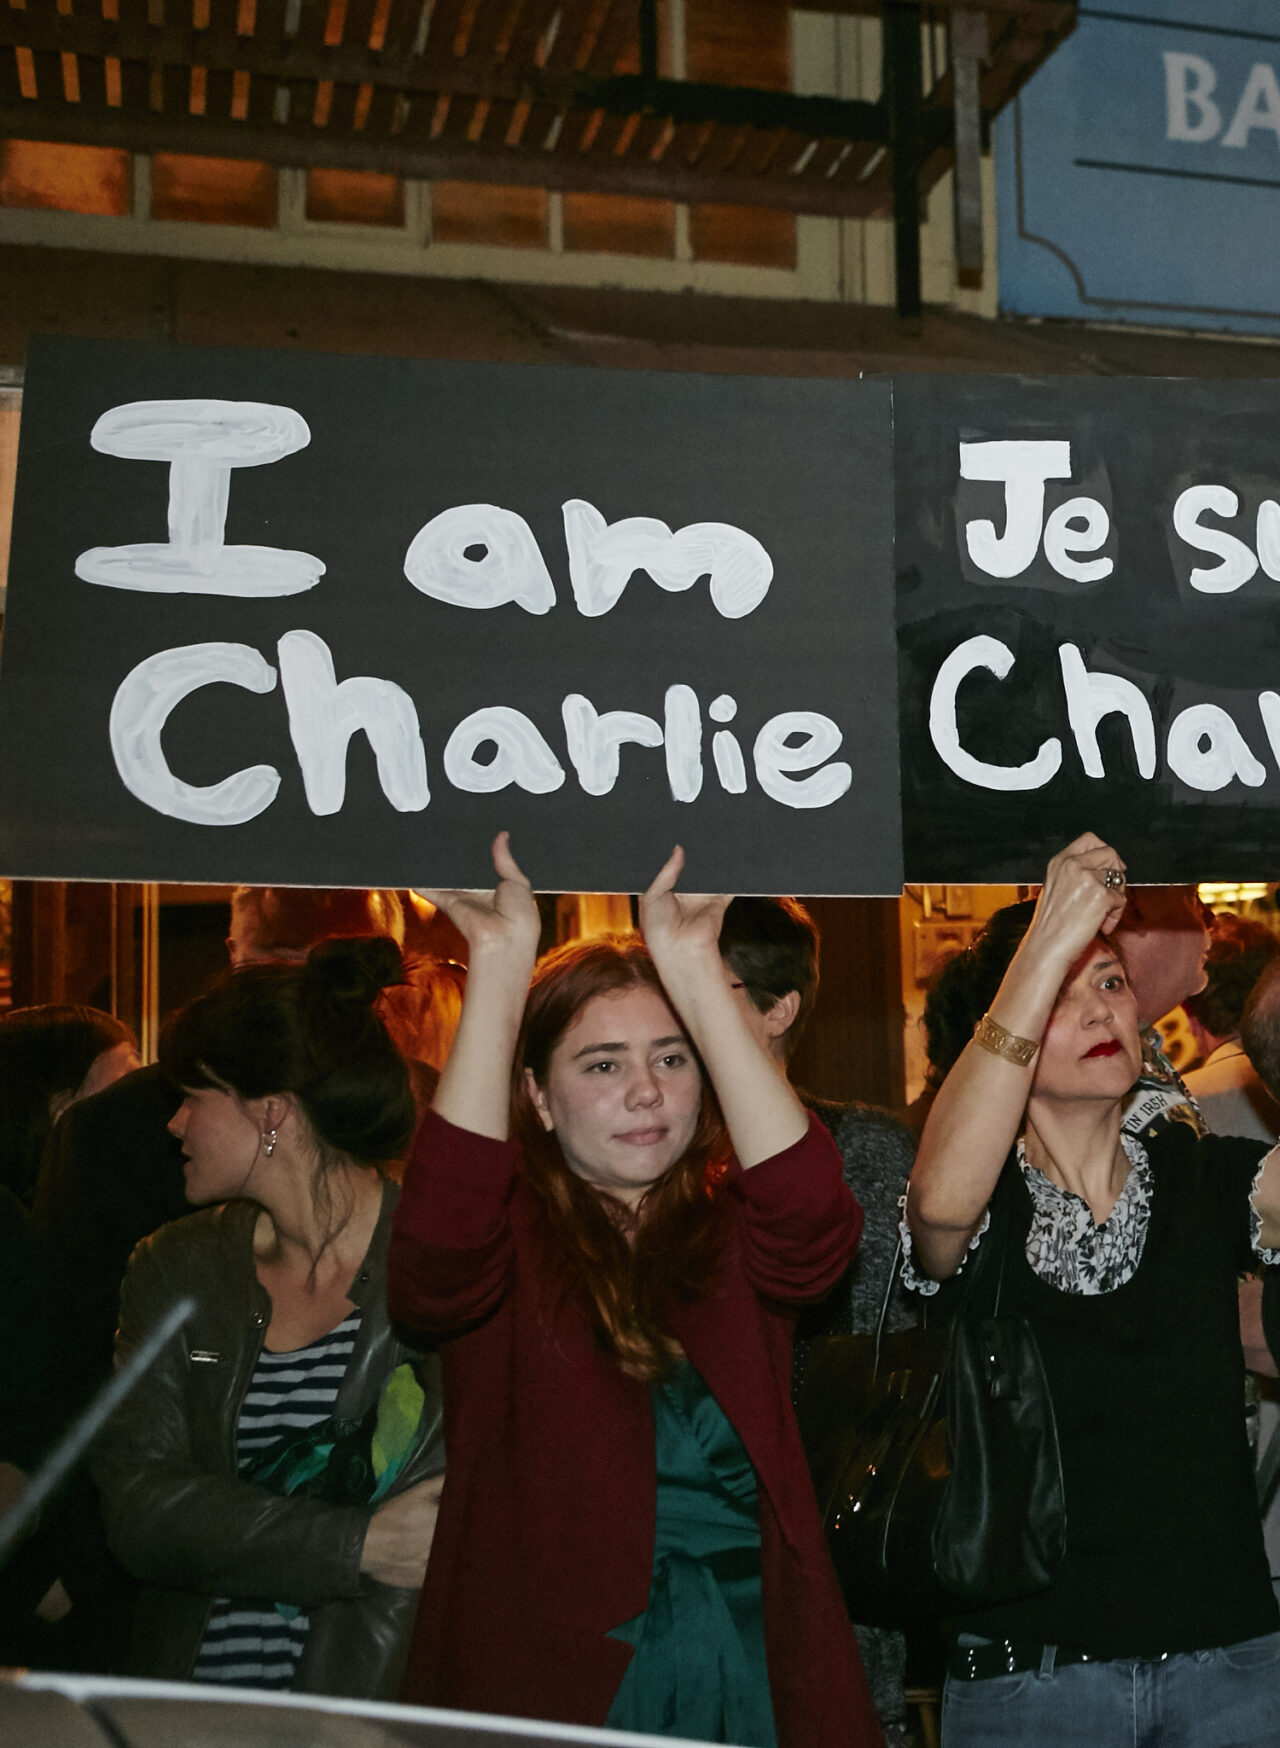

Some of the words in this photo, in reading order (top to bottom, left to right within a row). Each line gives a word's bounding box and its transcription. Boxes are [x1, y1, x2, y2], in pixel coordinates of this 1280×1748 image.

[74, 399, 327, 598] I
[403, 498, 775, 619] am
[959, 440, 1114, 584] Je
[109, 629, 853, 826] Charlie
